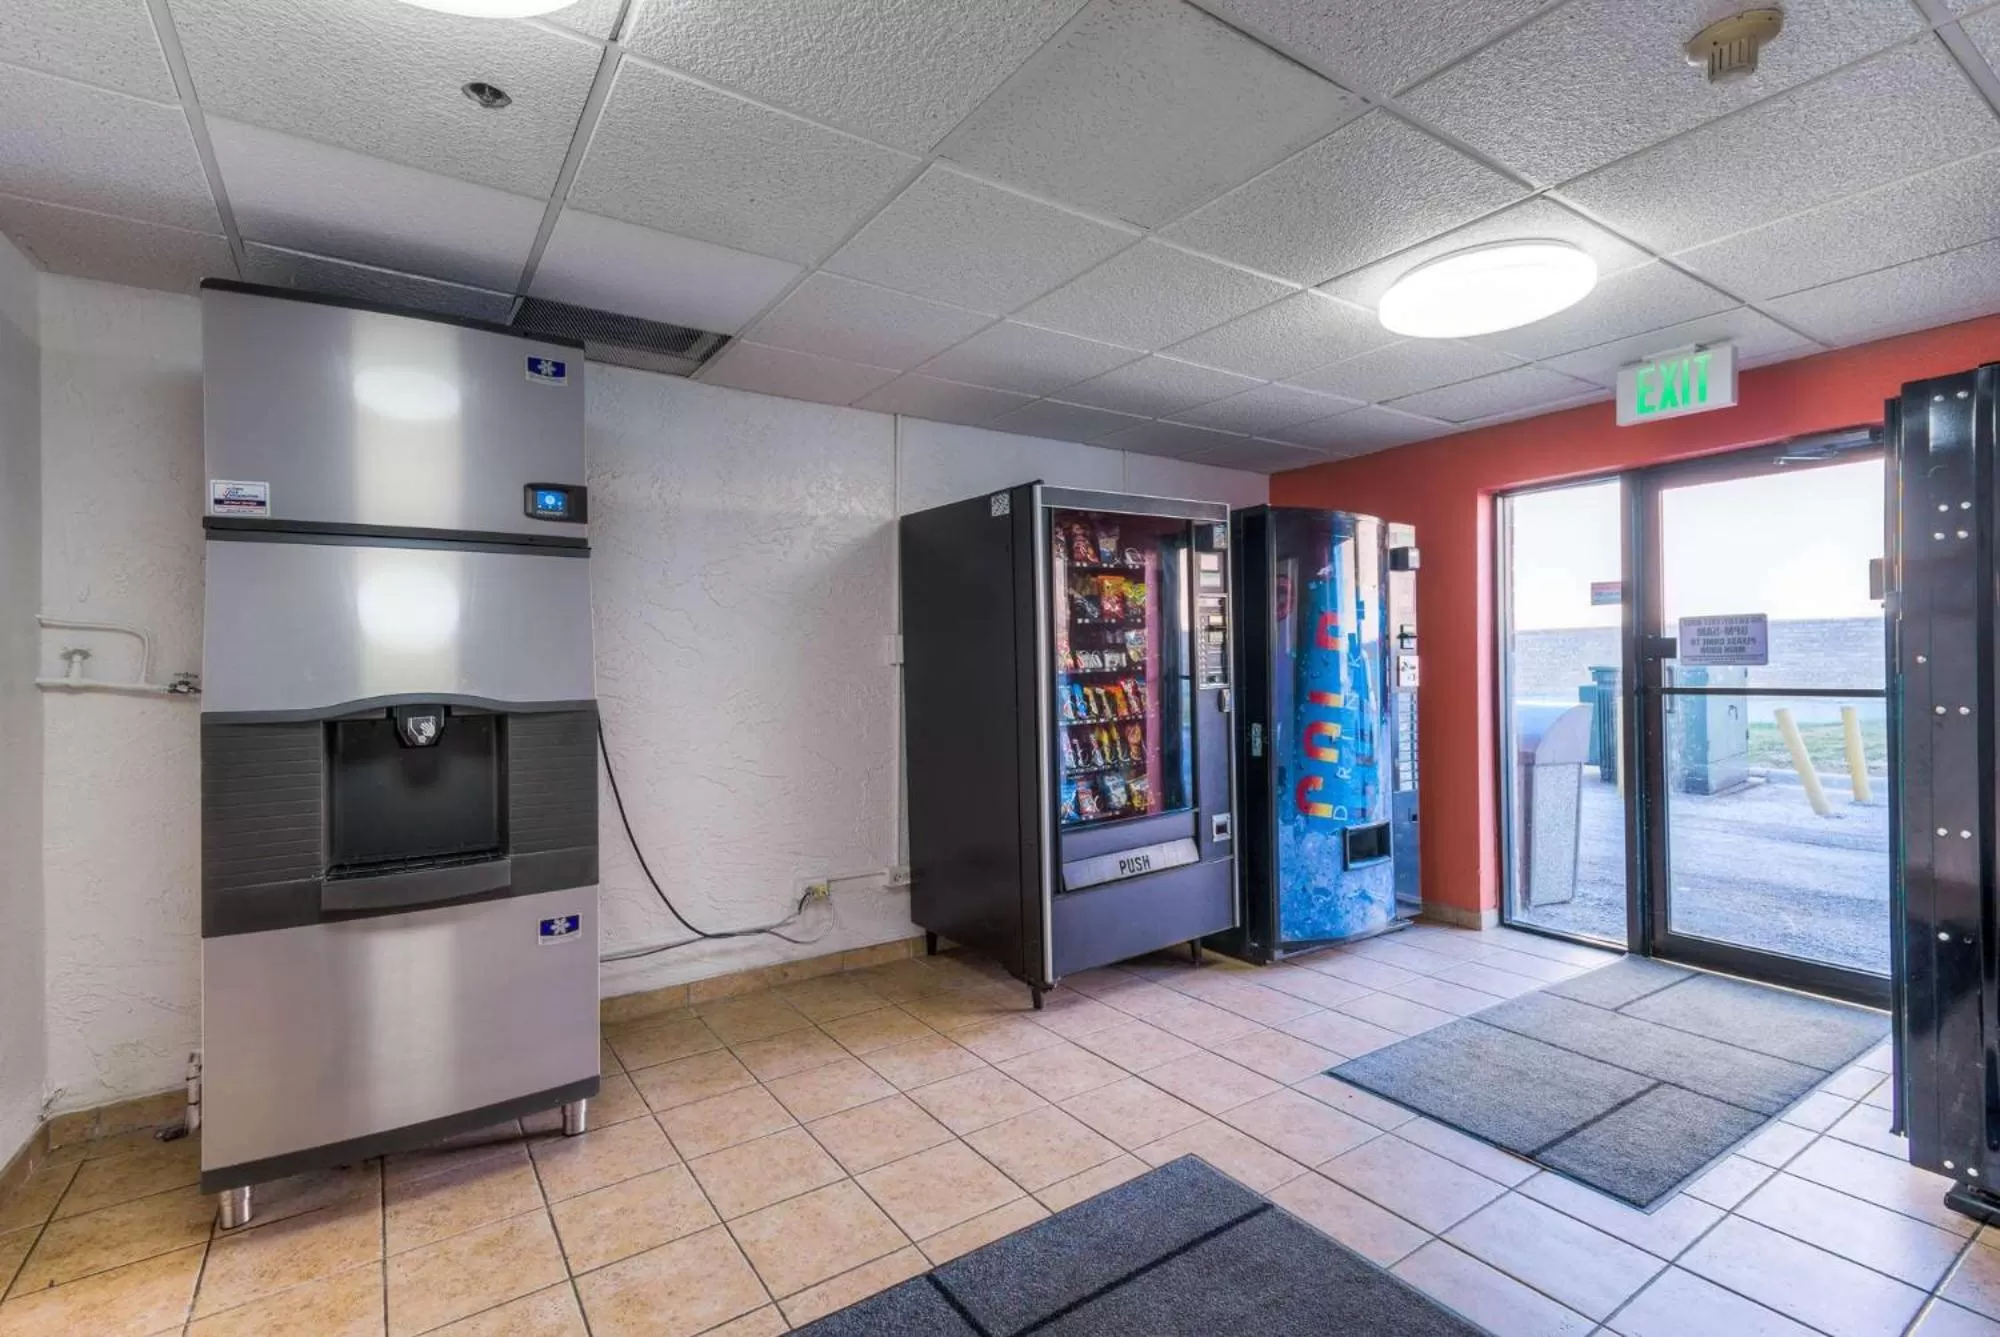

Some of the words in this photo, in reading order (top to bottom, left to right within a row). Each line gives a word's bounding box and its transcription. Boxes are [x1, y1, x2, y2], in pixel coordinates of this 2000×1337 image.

[1636, 353, 1714, 415] EXIT
[1332, 655, 1361, 821] DRINK
[1118, 855, 1151, 875] PUSH
